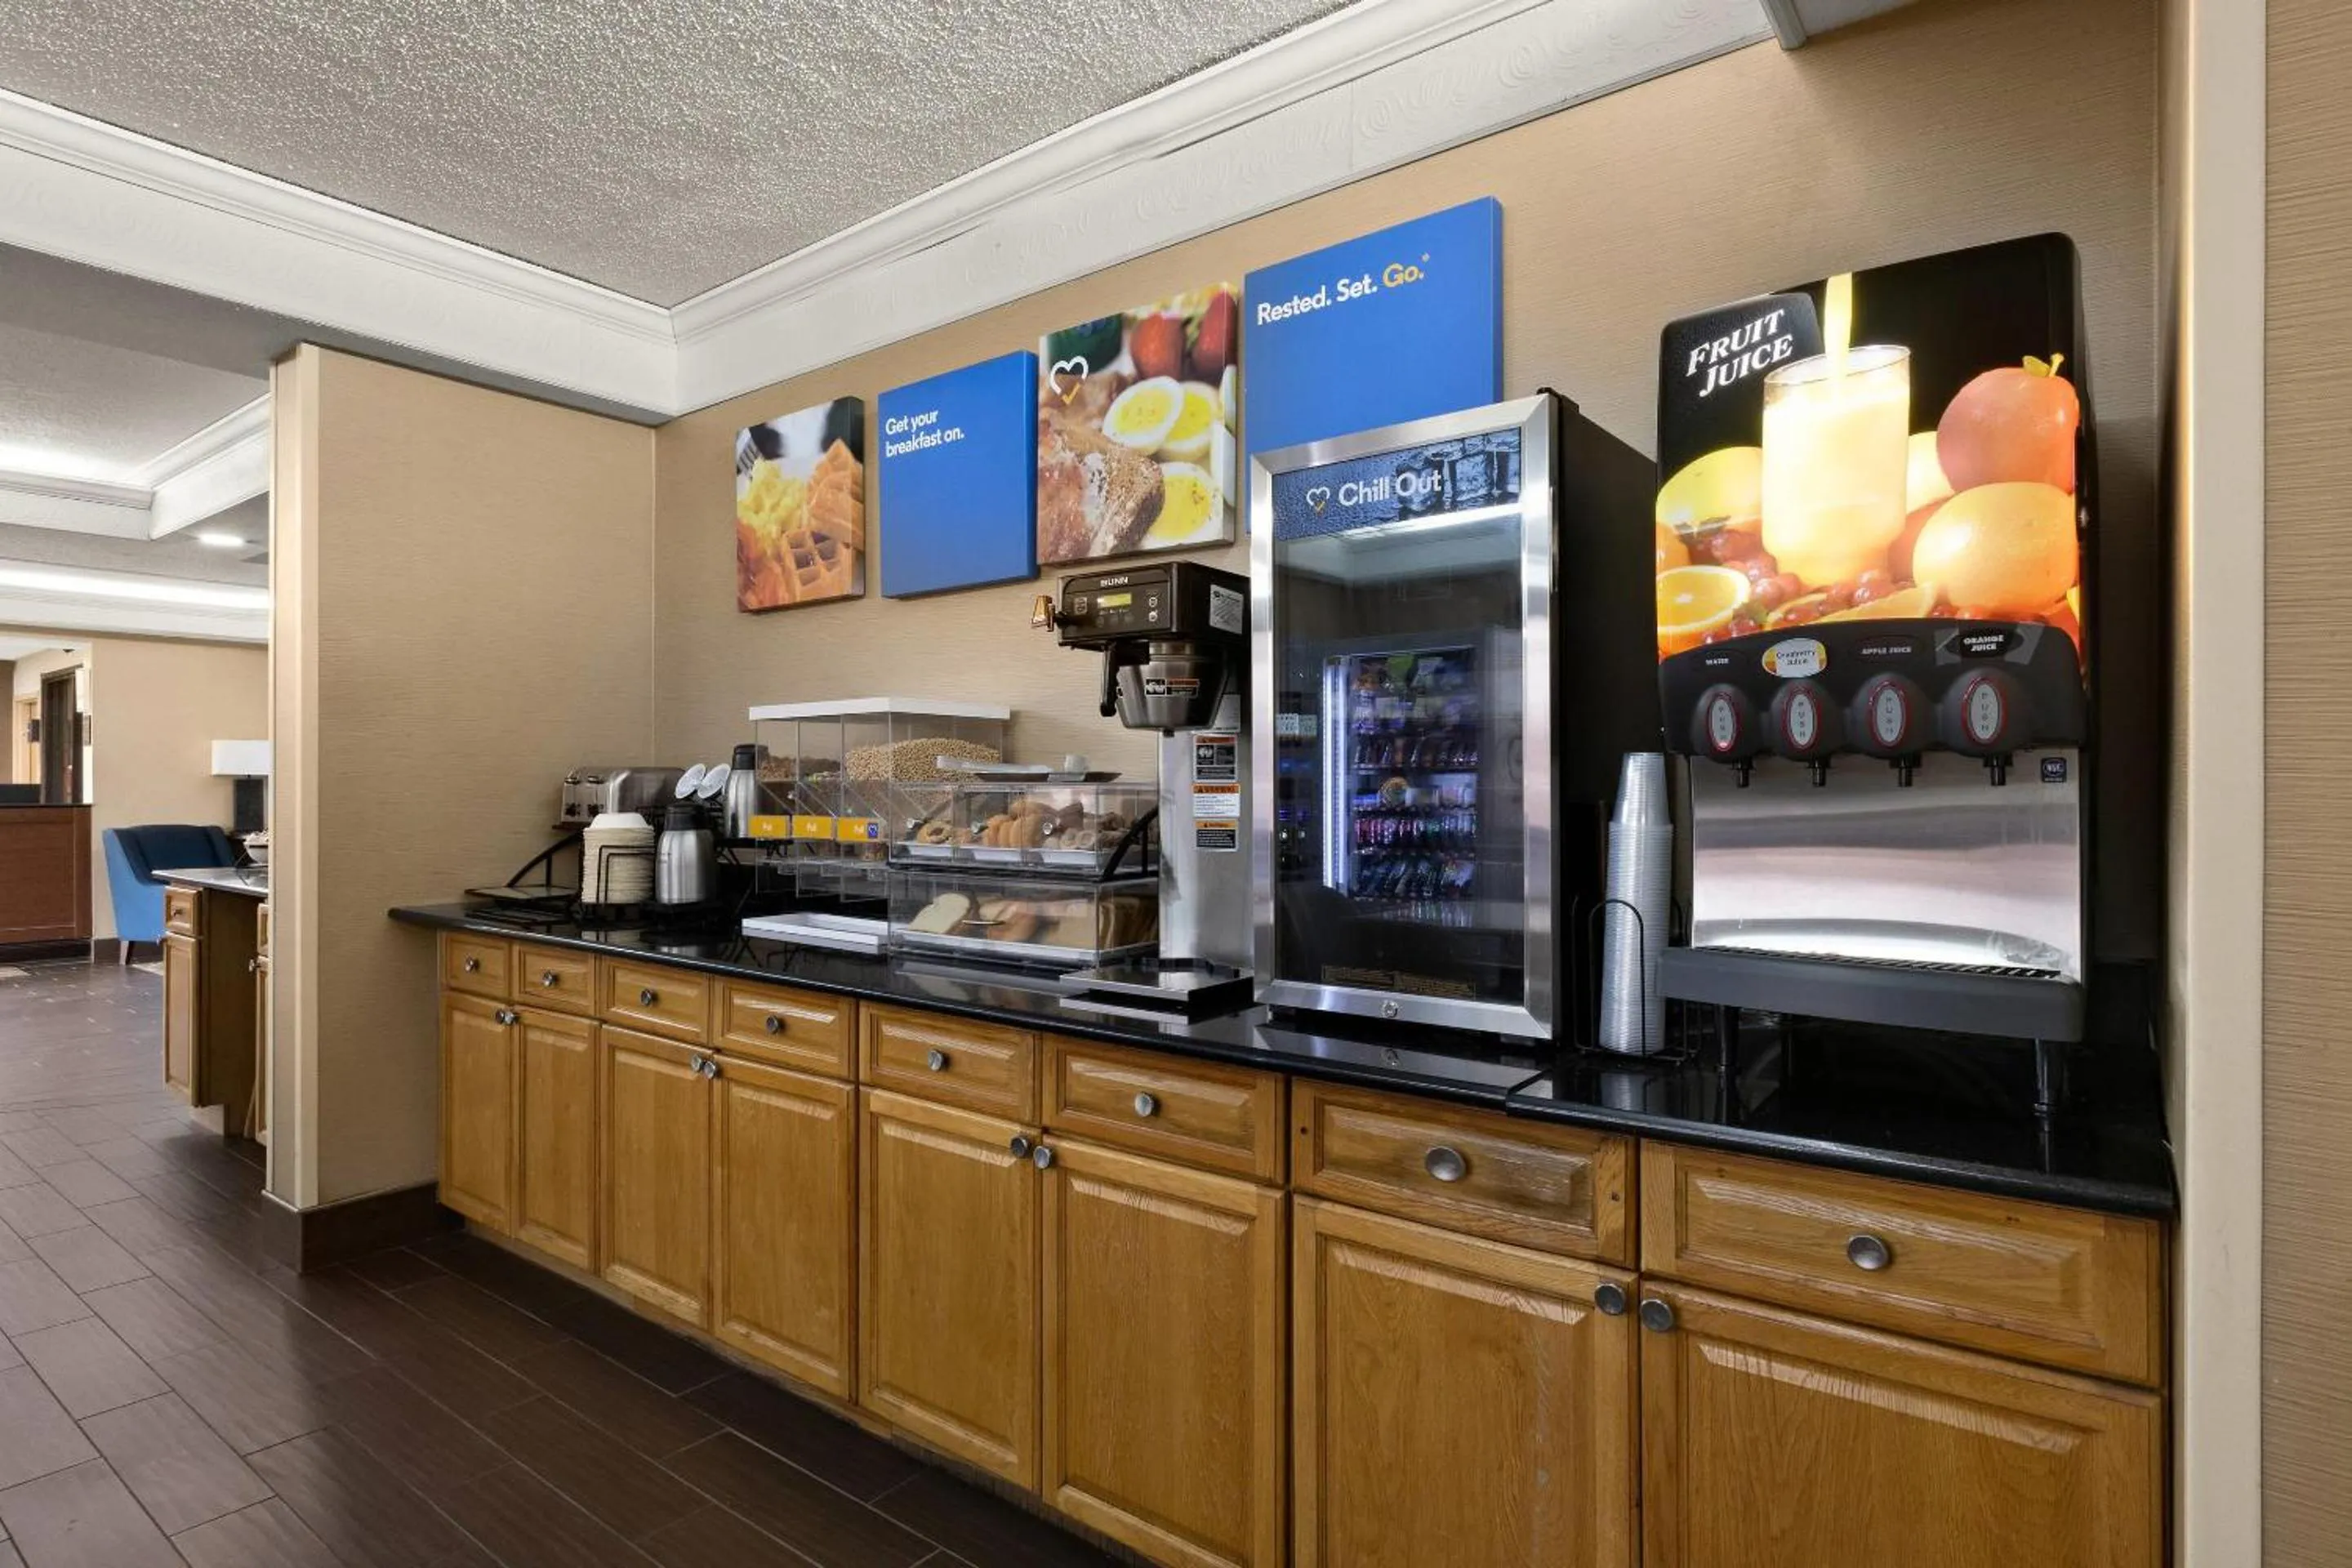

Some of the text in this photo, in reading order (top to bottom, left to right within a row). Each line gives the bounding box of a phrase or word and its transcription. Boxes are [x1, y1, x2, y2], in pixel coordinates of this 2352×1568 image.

[1257, 284, 1332, 326] Rested.
[1336, 274, 1378, 302] Set.
[1686, 309, 1785, 376] FRUIT
[1699, 333, 1793, 398] JUICE
[885, 410, 938, 435] Get your
[885, 427, 964, 457] breakfast on.
[1339, 470, 1441, 506] Chill Out
[1100, 577, 1129, 587] BUNN
[1963, 635, 2004, 645] ORANGE
[1971, 644, 1997, 652] JUICE
